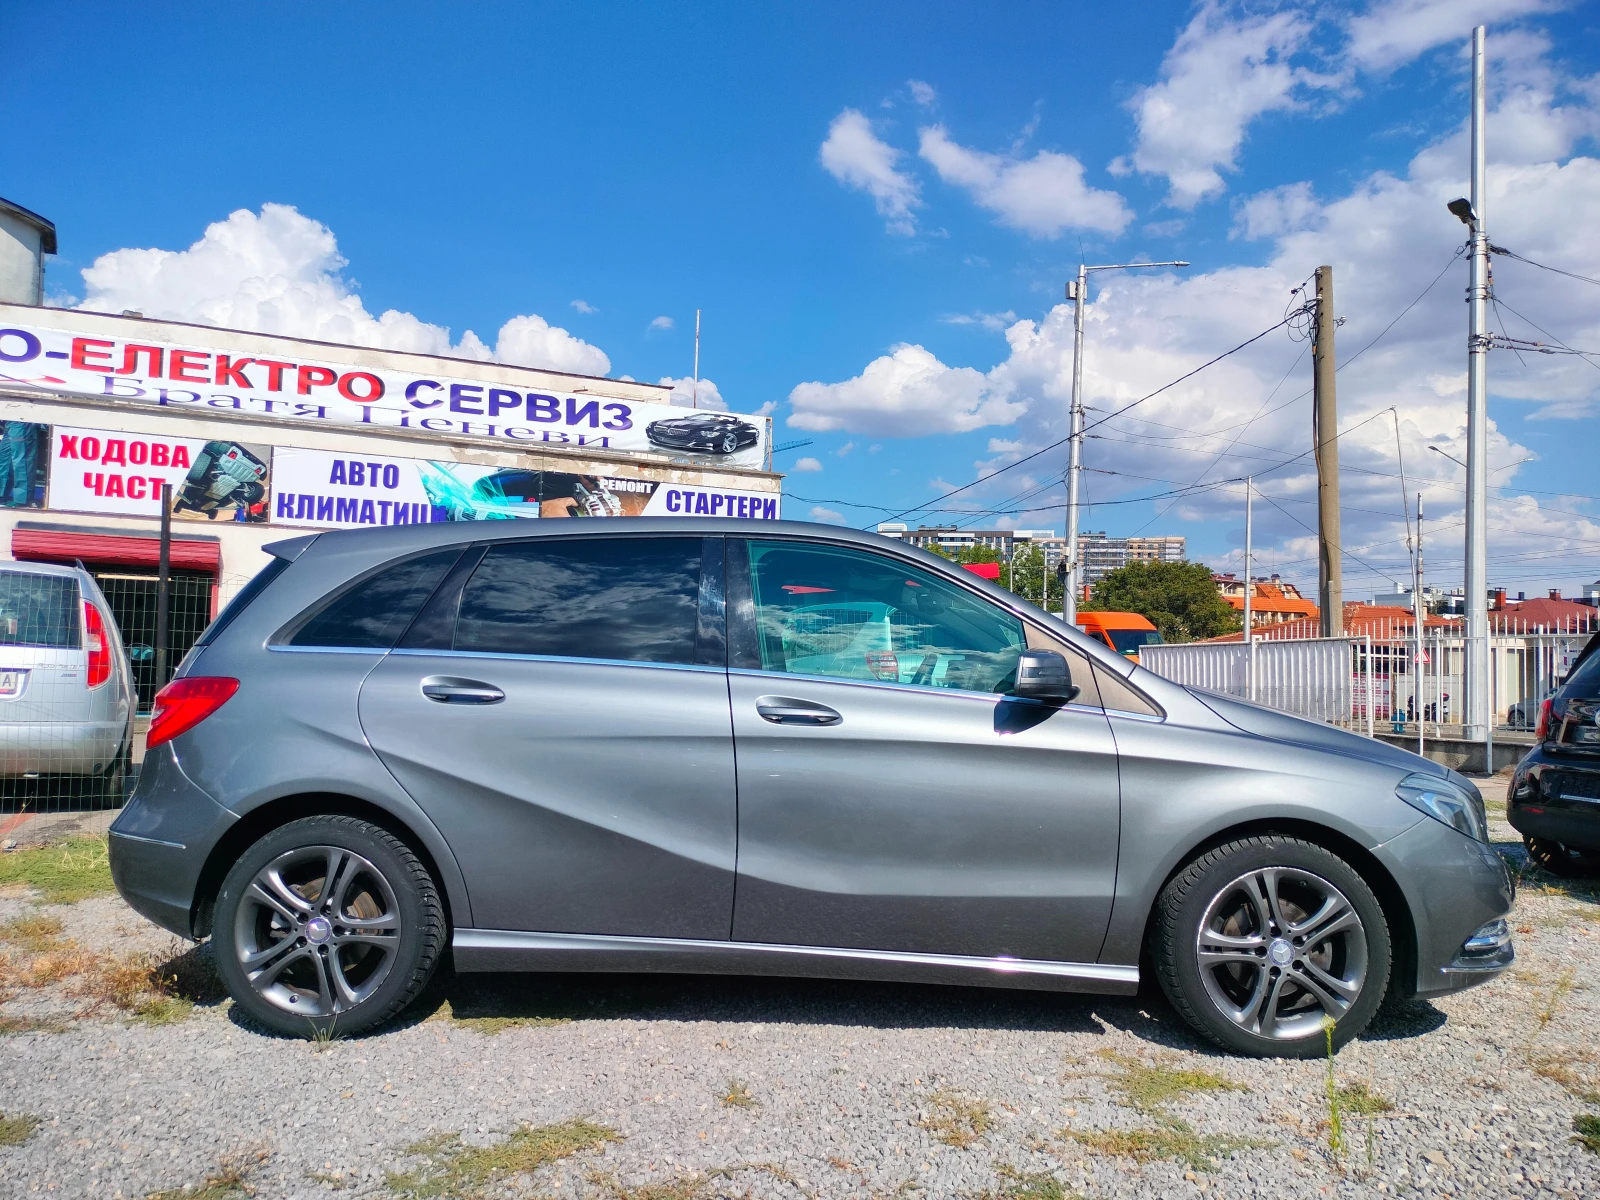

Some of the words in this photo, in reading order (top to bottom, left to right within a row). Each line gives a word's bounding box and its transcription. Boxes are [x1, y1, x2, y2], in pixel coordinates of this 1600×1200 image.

[96, 374, 333, 420] Братя
[404, 379, 634, 431] СЕРВИЗ
[59, 434, 191, 469] ХОДОВА
[83, 472, 167, 501] ЧАСТ
[329, 459, 400, 489] АВТО
[600, 478, 654, 494] РЕМОНТ
[666, 489, 777, 520] СТАРТЕРИ
